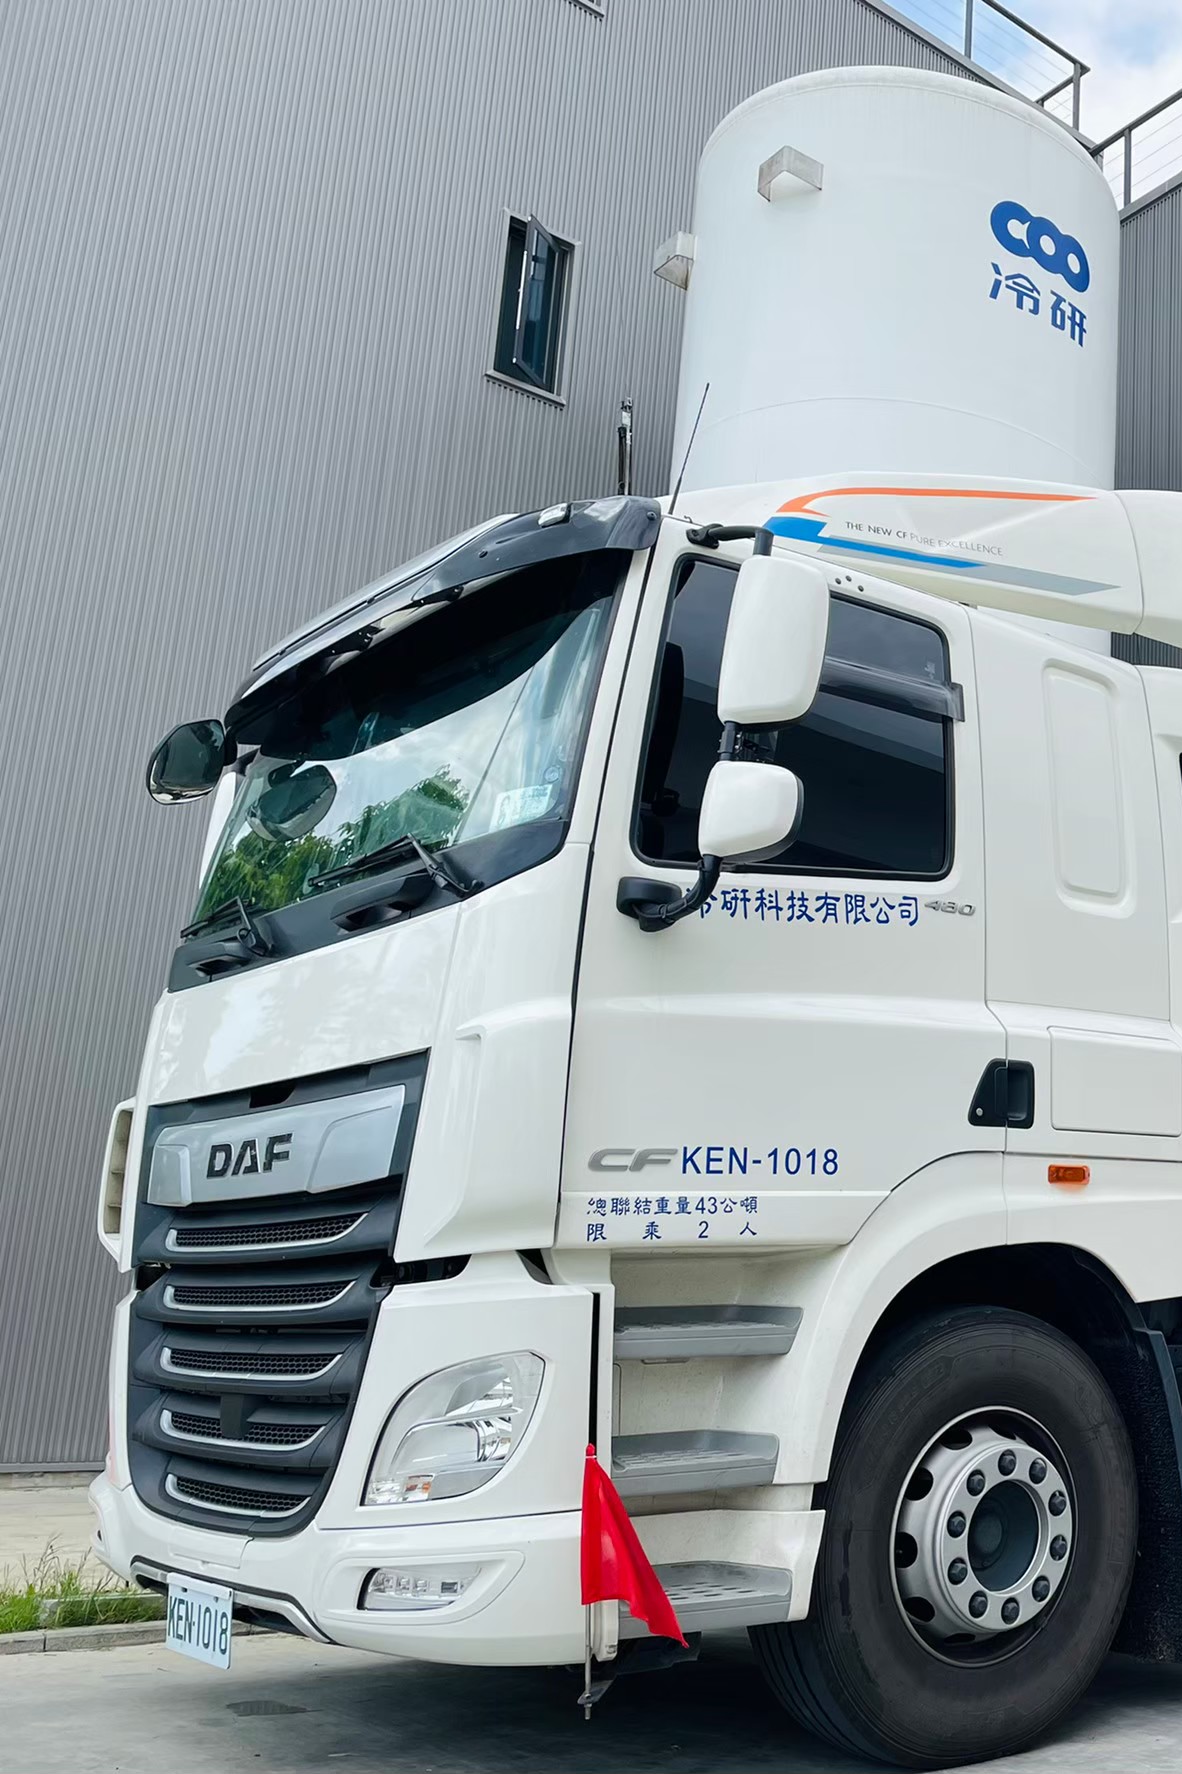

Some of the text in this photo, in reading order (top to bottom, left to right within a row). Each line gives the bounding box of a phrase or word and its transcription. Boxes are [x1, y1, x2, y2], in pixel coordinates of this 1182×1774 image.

[989, 261, 1087, 348] 冷研
[845, 521, 1003, 556] THE NEW CF PURE EXCELLENCE
[924, 900, 976, 916] 480
[206, 1132, 293, 1179] DAF
[588, 1148, 678, 1172] CF
[681, 1146, 838, 1175] KEN-1018
[586, 1196, 758, 1217] 總聯結重量43公噸
[587, 1220, 757, 1242] 限 乘 2 人
